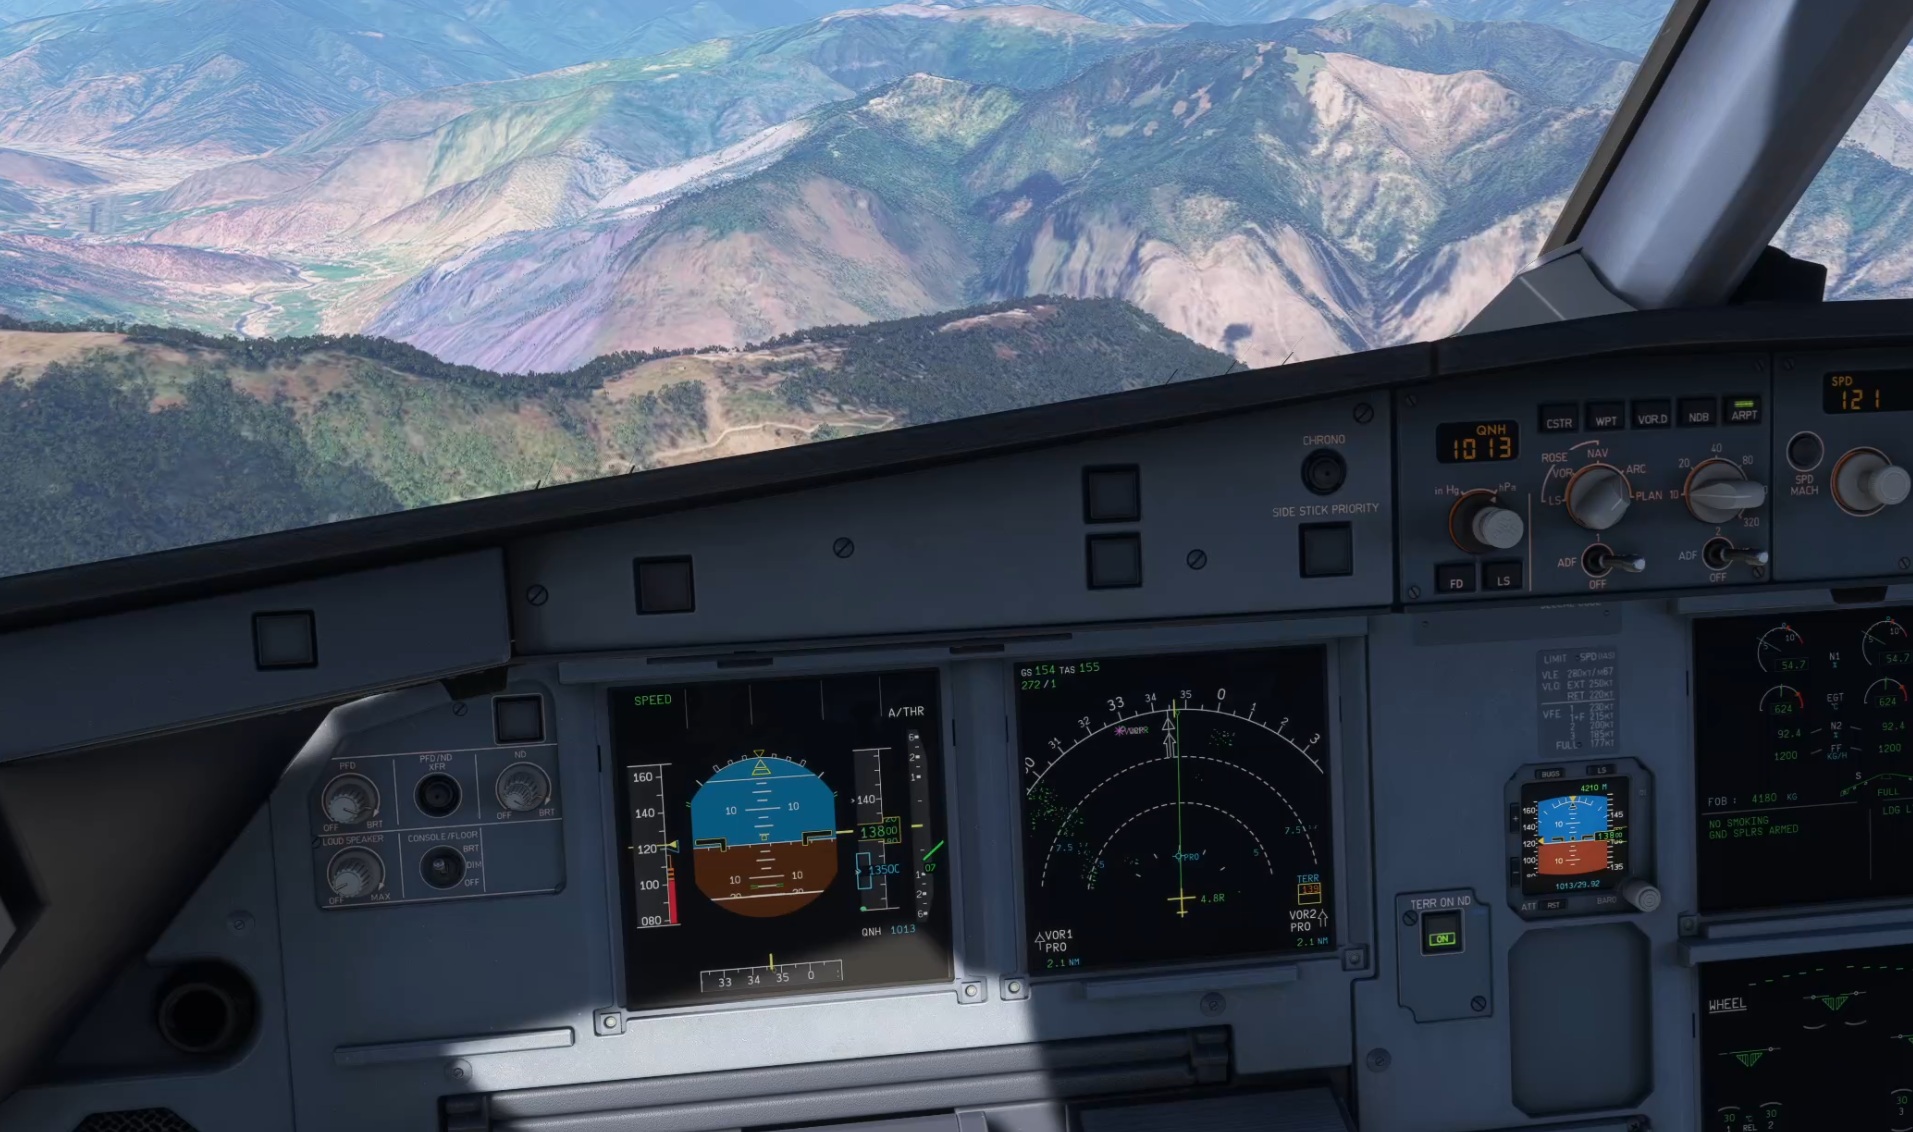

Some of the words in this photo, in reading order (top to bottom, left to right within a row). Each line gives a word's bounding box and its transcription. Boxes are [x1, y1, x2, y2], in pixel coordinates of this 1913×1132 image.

[1832, 376, 1853, 387] SPD
[1842, 389, 1880, 410] 121
[1638, 414, 1668, 425] VOR.D
[1689, 412, 1709, 423] NDB
[1731, 410, 1757, 421] ARPT
[1546, 418, 1573, 430] CSTR
[1595, 415, 1617, 427] WPT
[1476, 424, 1507, 436] QNH
[1303, 434, 1345, 446] CHRONO
[1453, 436, 1511, 460] 1013
[1711, 443, 1723, 453] 40
[1541, 452, 1568, 463] ROSE
[1587, 448, 1608, 459] NAV
[1678, 458, 1690, 469] 20
[1742, 455, 1754, 466] 80
[1553, 468, 1573, 478] VOR
[1626, 464, 1646, 474] ARC
[1796, 474, 1814, 485] SPD
[1434, 485, 1443, 495] in
[1446, 484, 1459, 497] Hg
[1498, 482, 1516, 494] hPa
[1791, 486, 1819, 496] MACH
[1636, 491, 1663, 502] PLAN
[1669, 489, 1680, 500] 10
[1549, 496, 1562, 506] LS
[1273, 506, 1295, 518] SIDE
[1299, 505, 1329, 516] STICK
[1331, 503, 1380, 515] PRIORITY
[1743, 517, 1760, 528] 320
[1678, 550, 1698, 561] ADF
[1557, 557, 1577, 568] ADF
[1497, 576, 1510, 587] LS
[1709, 572, 1727, 583] OFF
[1450, 578, 1464, 589] FD
[1589, 579, 1607, 590] OFF
[1544, 654, 1567, 664] LIMIT
[1580, 652, 1597, 661] SPD
[1829, 653, 1840, 661] N1
[1886, 653, 1910, 663] 54.7
[1021, 669, 1032, 677] GS
[1035, 665, 1056, 676] 154
[1059, 666, 1075, 675] TAS
[1080, 662, 1100, 673] 155
[1782, 660, 1806, 670] 54.7
[1542, 670, 1559, 680] VLE
[1567, 680, 1586, 690] EXT
[1145, 693, 1157, 702] 34
[1180, 690, 1192, 699] 35
[1567, 691, 1585, 700] RET
[1827, 693, 1844, 702] EGT
[634, 694, 672, 706] SPEED
[1107, 696, 1125, 711] 33
[1879, 697, 1896, 706] 624
[888, 706, 925, 718] A/THR
[1774, 704, 1792, 714] 624
[1543, 710, 1561, 719] VFE
[1078, 716, 1091, 728] 32
[1280, 717, 1289, 726] 2
[1831, 722, 1842, 730] N2
[1882, 722, 1905, 731] 92.4
[1309, 733, 1321, 744] 3
[1777, 729, 1801, 738] 92.4
[1048, 737, 1062, 749] 31
[1831, 744, 1842, 752] FF
[1879, 743, 1901, 753] 1200
[420, 753, 452, 763] PFD/ND
[515, 751, 527, 759] ND
[1774, 751, 1797, 761] 1200
[1827, 752, 1847, 760] KG/H
[340, 762, 356, 770] PFD
[429, 763, 446, 771] XFR
[633, 772, 653, 783] 160
[1581, 784, 1598, 792] 4210
[1877, 788, 1899, 796] FULL
[857, 794, 876, 805] 140
[1708, 797, 1728, 807] FOB
[1752, 793, 1777, 804] 4180
[1786, 793, 1798, 801] KG
[726, 806, 737, 815] 10
[788, 802, 800, 811] 10
[1883, 806, 1900, 815] LDG
[497, 812, 512, 820] OFF
[539, 808, 555, 817] BRT
[636, 808, 655, 819] 140
[367, 820, 383, 828] BRT
[1709, 819, 1721, 828] NO
[1727, 816, 1769, 827] SMOKING
[323, 824, 339, 832] OFF
[1284, 826, 1301, 835] 7.5
[1709, 830, 1727, 840] GND
[1733, 827, 1763, 838] SPLRS
[1769, 824, 1799, 835] ARMED
[322, 837, 344, 846] LOUD
[346, 835, 384, 844] SPEAKER
[1523, 840, 1536, 848] 120
[463, 844, 479, 852] BRT
[638, 844, 657, 854] 120
[1056, 844, 1073, 852] 7.5
[1184, 853, 1199, 861] PRO
[466, 861, 482, 869] DIM
[925, 864, 936, 872] 07
[792, 871, 803, 879] 10
[1297, 874, 1319, 883] TERR
[640, 880, 660, 890] 100
[730, 876, 741, 885] 10
[1556, 880, 1600, 890] 1013/29.92
[371, 893, 390, 901] MAX
[1411, 898, 1437, 910] TERR
[1440, 897, 1454, 907] ON
[1457, 896, 1471, 906] ND
[1521, 903, 1537, 911] ATT
[1290, 909, 1316, 920] VOR2
[641, 916, 662, 926] 080
[862, 928, 882, 937] QNH
[890, 924, 916, 935] 1013
[1291, 921, 1311, 932] PRO
[1044, 929, 1073, 940] VOR1
[1436, 935, 1449, 943] ON
[1045, 942, 1067, 952] PRO
[1297, 938, 1314, 947] 2.1
[1317, 937, 1328, 945] NM
[1047, 959, 1066, 968] 2.1
[1069, 958, 1080, 966] NM
[718, 978, 732, 988] 33
[747, 976, 760, 985] 34
[776, 972, 790, 983] 35
[1709, 997, 1747, 1011] WHEEL
[1897, 1096, 1908, 1104] 30
[1723, 1114, 1735, 1123] 30
[1766, 1110, 1777, 1118] 30
[1743, 1124, 1758, 1132] REL
[1768, 1121, 1774, 1129] 2
